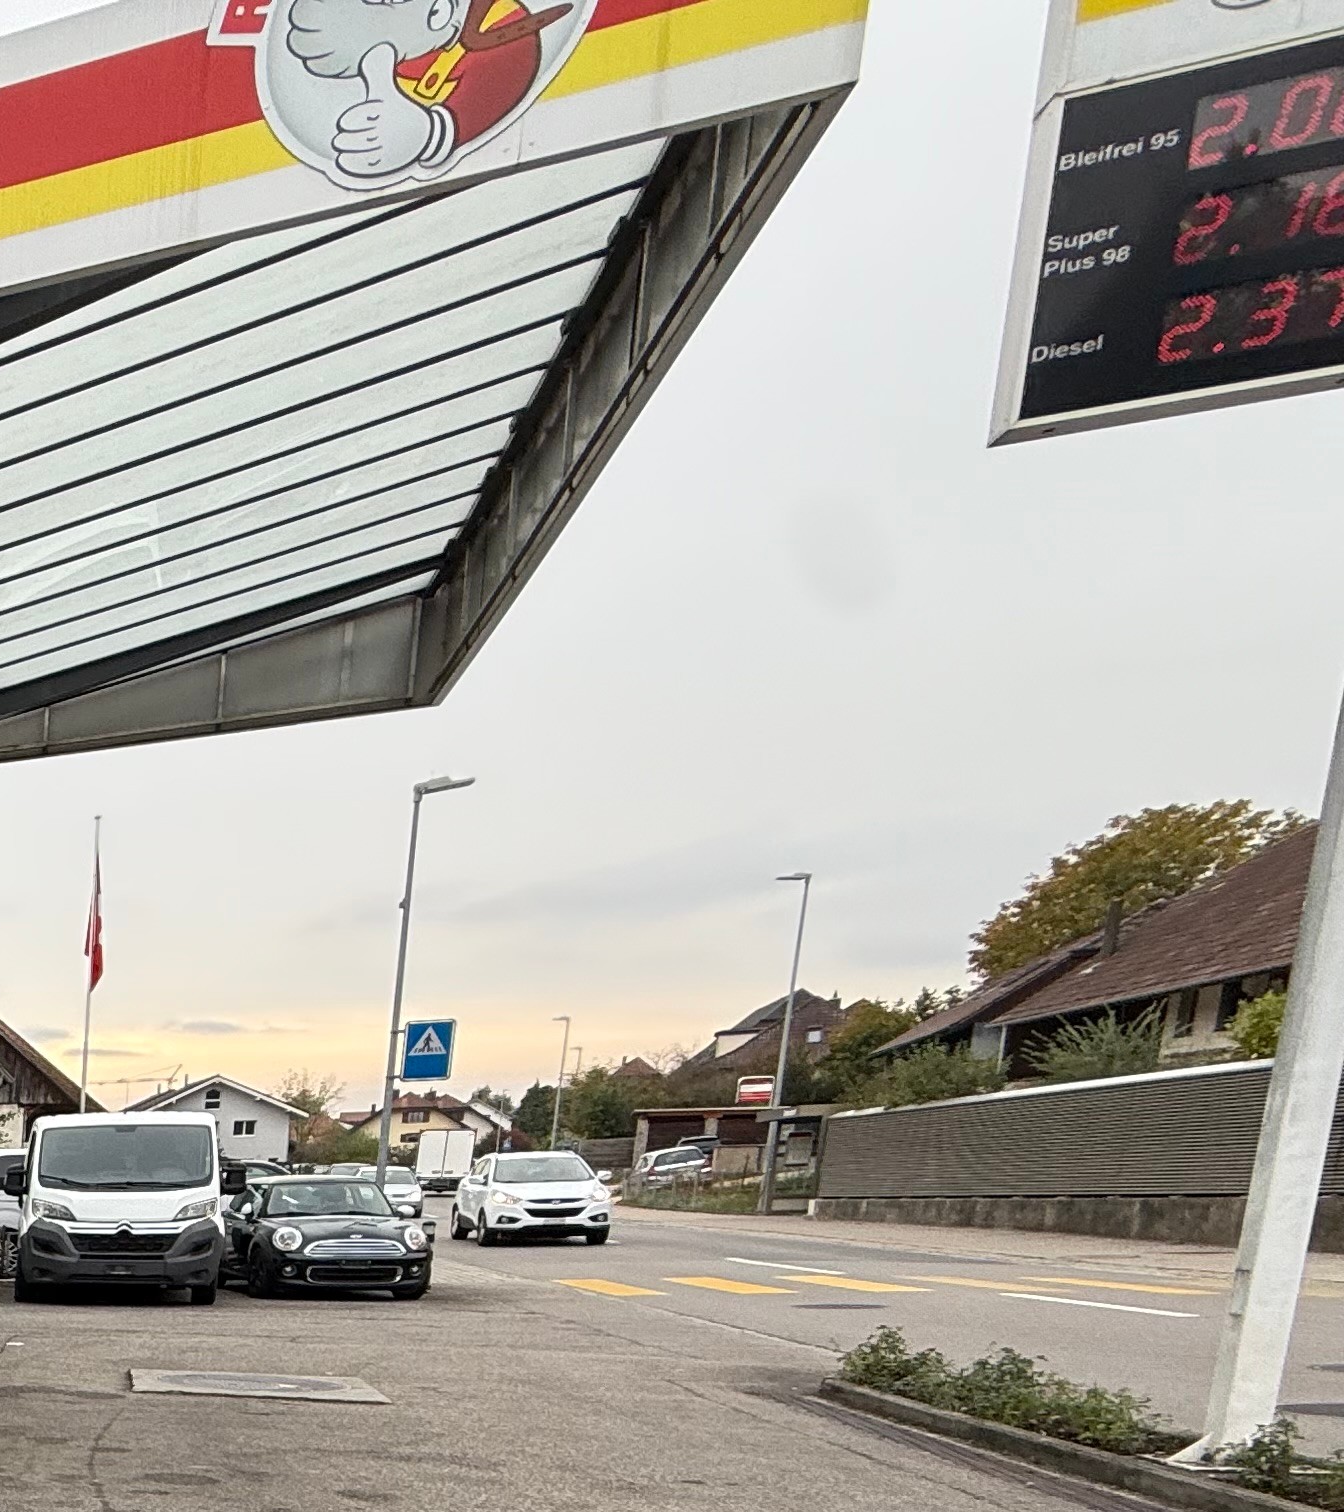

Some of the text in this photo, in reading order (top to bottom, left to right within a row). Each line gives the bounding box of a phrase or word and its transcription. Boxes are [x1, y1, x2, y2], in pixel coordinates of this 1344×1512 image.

[1058, 74, 1344, 172] Bleifrei 95 2.0
[1046, 224, 1121, 254] Super
[1043, 254, 1096, 279] Plus
[1101, 245, 1131, 266] 98
[1030, 333, 1105, 364] Diesel
